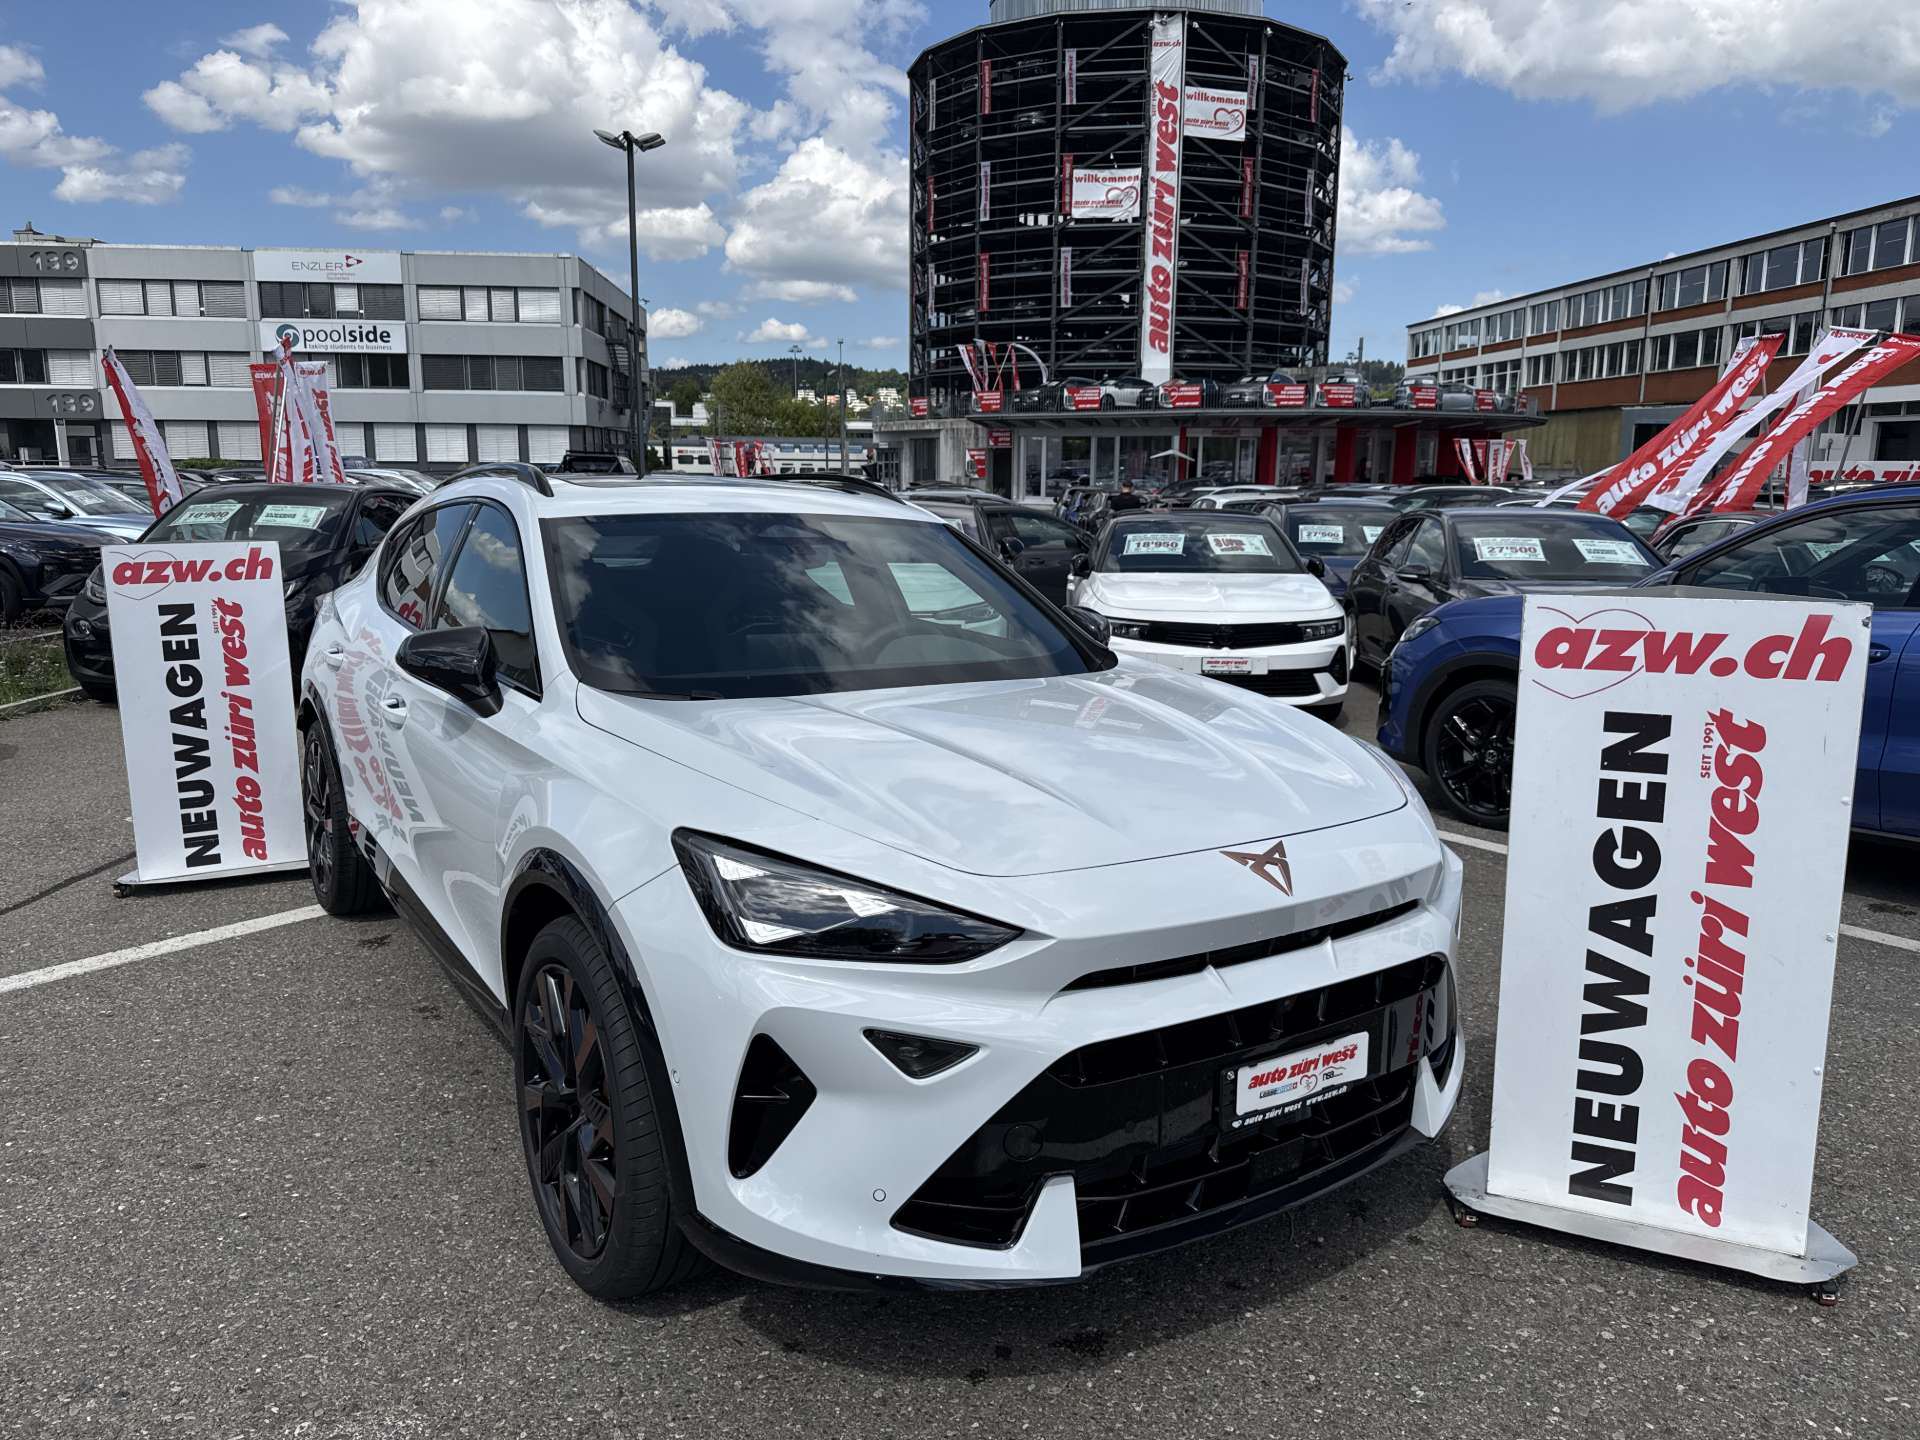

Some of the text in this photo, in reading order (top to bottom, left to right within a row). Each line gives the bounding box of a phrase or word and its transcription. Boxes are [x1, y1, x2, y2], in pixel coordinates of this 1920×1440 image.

[1186, 91, 1246, 105] willkommen
[1074, 173, 1139, 184] willkommen
[1146, 80, 1179, 354] auto züri west
[29, 251, 80, 272] 139
[292, 261, 344, 271] ENZLER
[303, 324, 391, 349] poolside
[309, 343, 329, 351] taking
[46, 393, 95, 413] 139
[1595, 462, 1658, 515] auto
[1657, 410, 1714, 469] züri
[112, 547, 275, 586] azw.ch
[1487, 546, 1537, 554] 27'500
[1534, 614, 1853, 682] azw.ch
[157, 602, 222, 868] NEUWAGEN
[211, 597, 268, 861] auto züri west
[1700, 722, 1714, 779] SEIT 1991
[1568, 710, 1672, 1207] NEUWAGEN
[1673, 707, 1767, 1228] auto züri west
[1248, 1044, 1358, 1090] auto züri west
[1243, 1114, 1263, 1126] auto
[1265, 1107, 1283, 1119] züri
[1284, 1101, 1302, 1114] west
[1306, 1085, 1348, 1106] www.azw.ch
